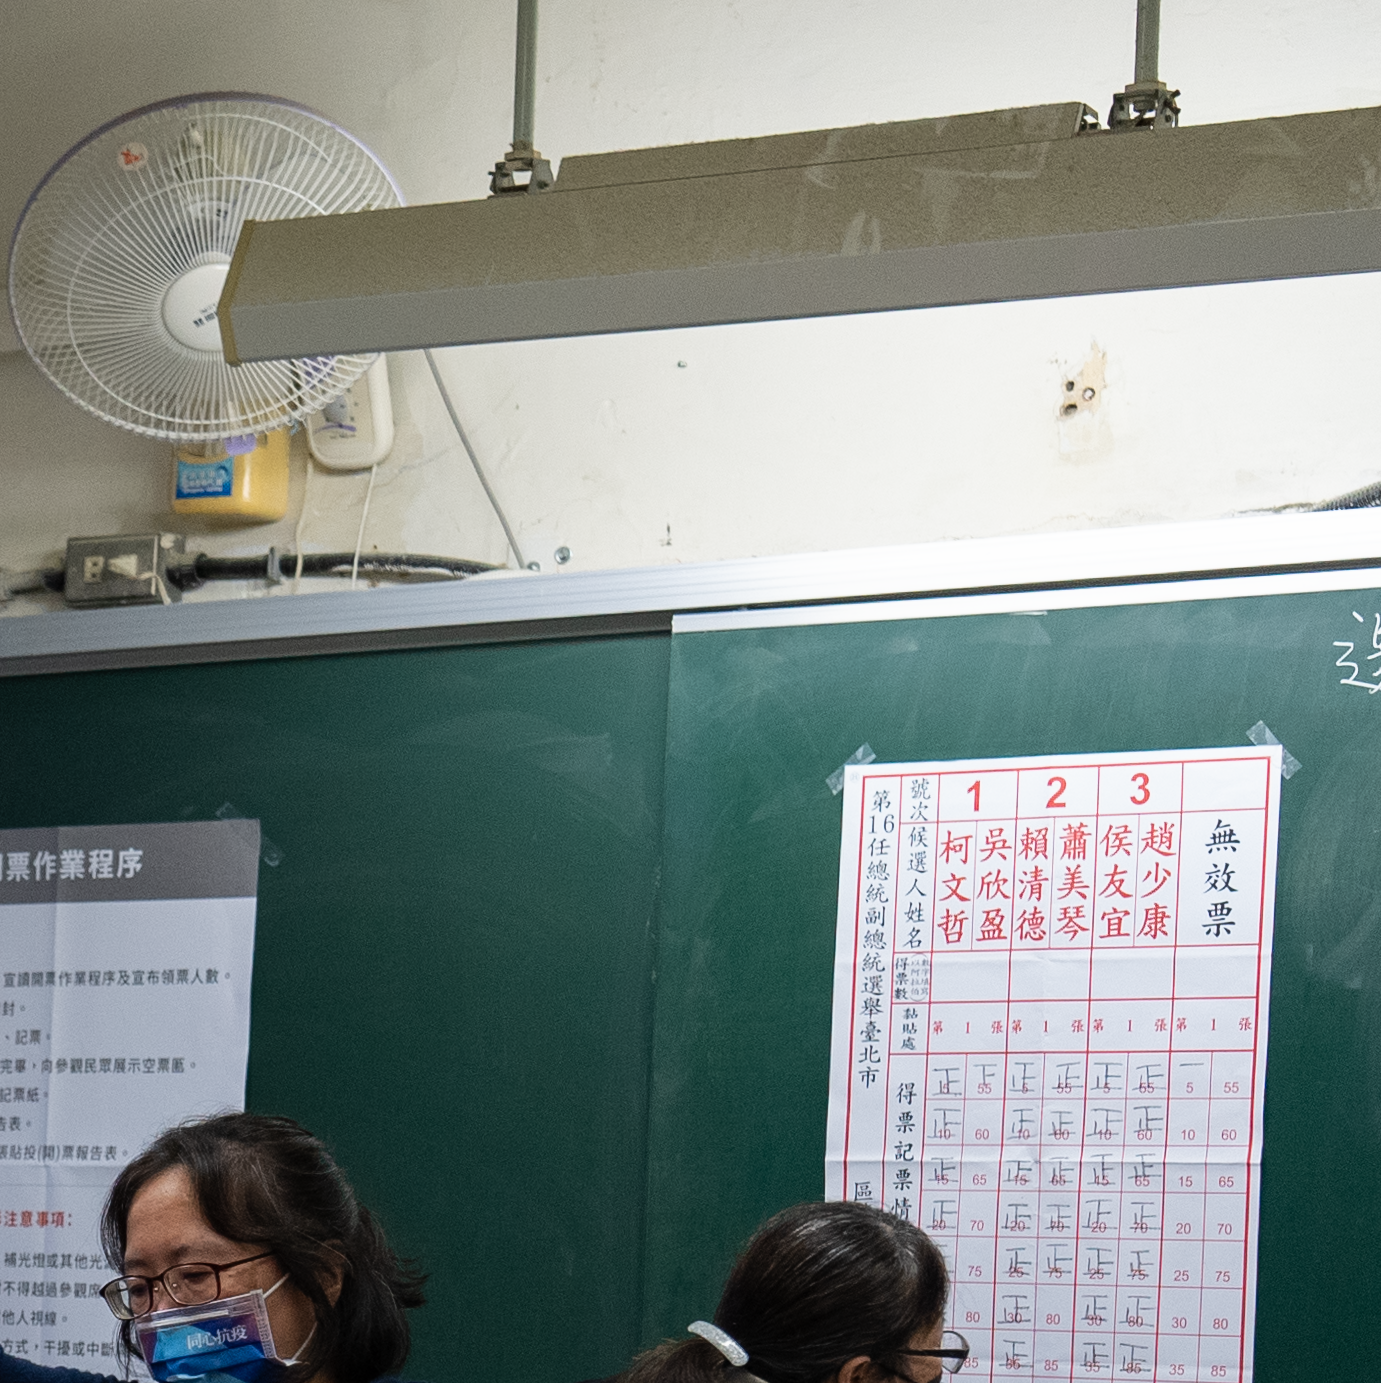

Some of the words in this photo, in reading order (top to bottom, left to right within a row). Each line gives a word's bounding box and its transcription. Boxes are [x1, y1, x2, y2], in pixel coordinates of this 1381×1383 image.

[968, 781, 980, 811] 1
[1047, 777, 1066, 808] 2
[1131, 773, 1150, 804] 3
[910, 777, 930, 821] 號次
[1054, 822, 1091, 942] 蕭美琴
[1098, 822, 1134, 938] 侯友宜
[1136, 821, 1177, 938] 趙少康
[1201, 819, 1240, 937] 無效票
[903, 826, 928, 950] 候選人姓名
[938, 830, 973, 943] 柯文哲
[975, 828, 1012, 942] 吳欣盈
[1015, 827, 1049, 942] 賴清德
[934, 1022, 942, 1033] 第
[967, 1023, 969, 1032] 1
[993, 1021, 1002, 1032] 張
[1013, 1020, 1021, 1032] 第
[1044, 1021, 1047, 1032] 1
[1072, 1020, 1083, 1032] 張
[1094, 1019, 1103, 1031] 第
[1129, 1020, 1132, 1031] 1
[1156, 1019, 1166, 1030] 張
[1177, 1018, 1186, 1030] 第
[1212, 1019, 1215, 1030] 1
[1240, 1018, 1251, 1029] 張
[978, 1083, 992, 1093] 55
[1187, 1082, 1194, 1093] 5
[1224, 1082, 1239, 1093] 55
[975, 1129, 990, 1139] 60
[1182, 1130, 1195, 1140] 10
[1221, 1129, 1237, 1140] 60
[973, 1174, 986, 1185] 65
[1179, 1176, 1193, 1187] 15
[1218, 1176, 1234, 1187] 65
[971, 1220, 984, 1231] 70
[1176, 1222, 1192, 1235] 20
[1218, 1223, 1232, 1235] 70
[969, 1265, 982, 1277] 75
[1174, 1270, 1190, 1281] 25
[1217, 1270, 1230, 1282] 75
[966, 1311, 980, 1323] 80
[1046, 1314, 1060, 1325] 80
[1173, 1317, 1187, 1328] 30
[1213, 1318, 1228, 1329] 80
[186, 1324, 248, 1350] 同心抗疫
[962, 1356, 978, 1367] 85
[1045, 1359, 1058, 1371] 85
[1170, 1364, 1184, 1375] 35
[1211, 1365, 1226, 1377] 85
